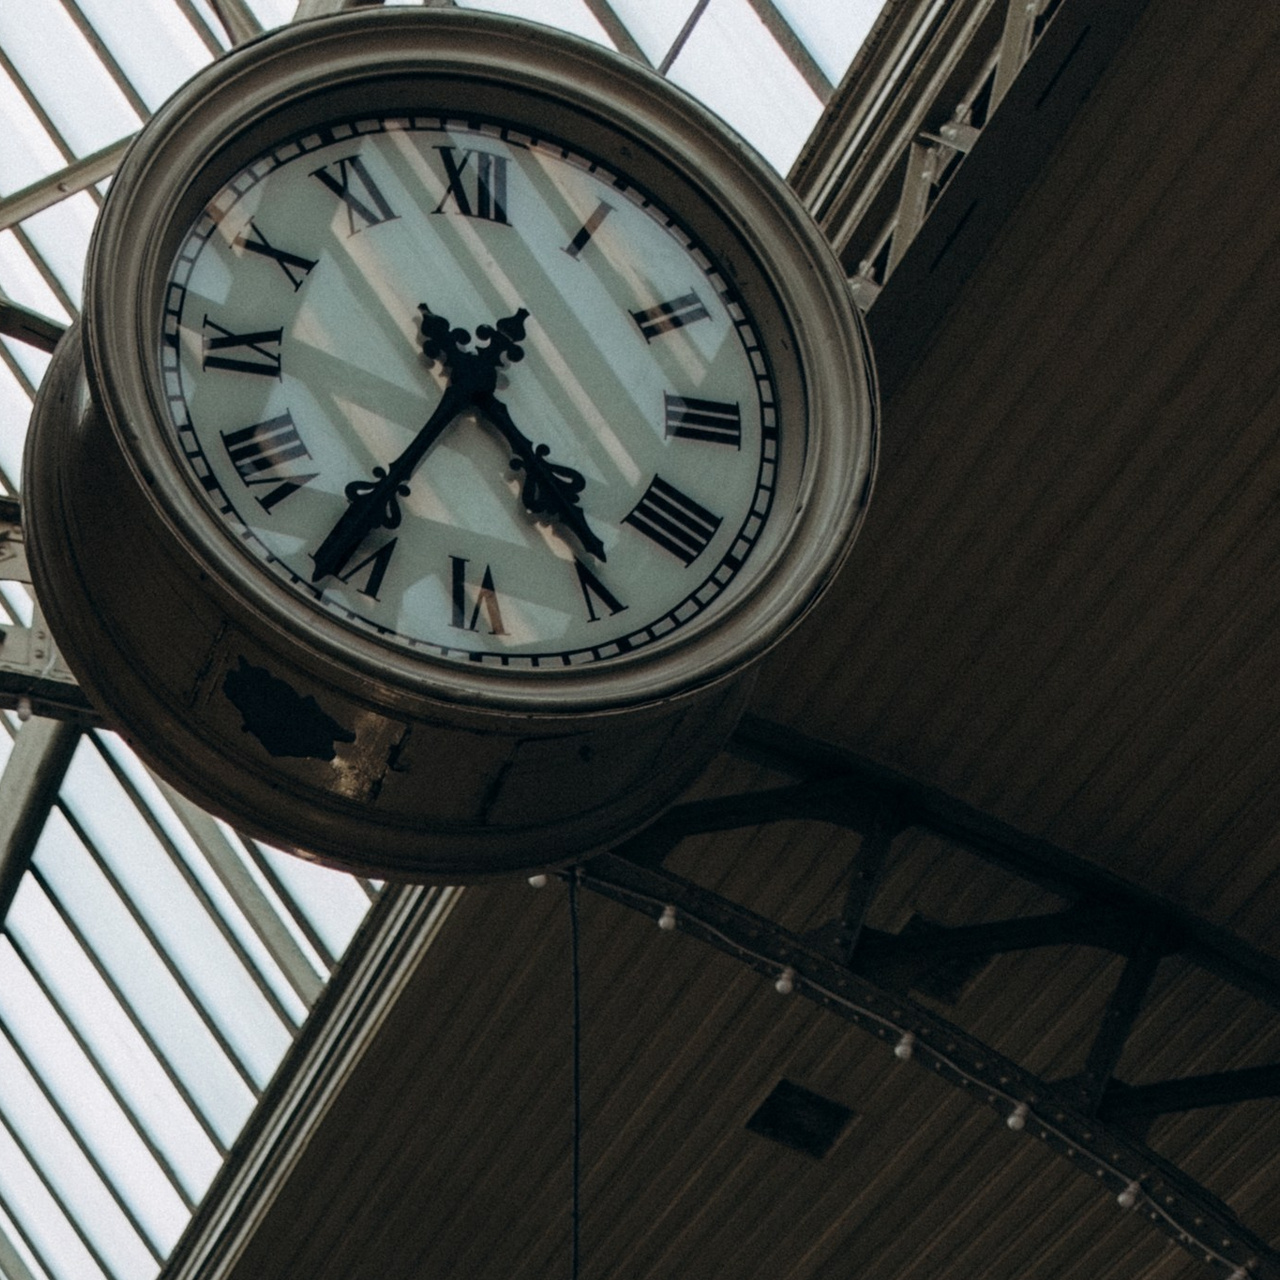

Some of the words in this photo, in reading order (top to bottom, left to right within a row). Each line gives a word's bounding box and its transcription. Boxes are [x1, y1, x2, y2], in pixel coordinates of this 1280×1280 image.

[308, 154, 402, 236] XI
[431, 146, 514, 226] XII
[230, 216, 320, 292] X
[560, 197, 616, 261] I
[202, 313, 284, 383] IX
[628, 287, 712, 344] II
[665, 393, 741, 451] III
[219, 408, 320, 515] VIII
[621, 473, 724, 568] IIII
[448, 554, 511, 636] VI
[573, 557, 628, 624] V
